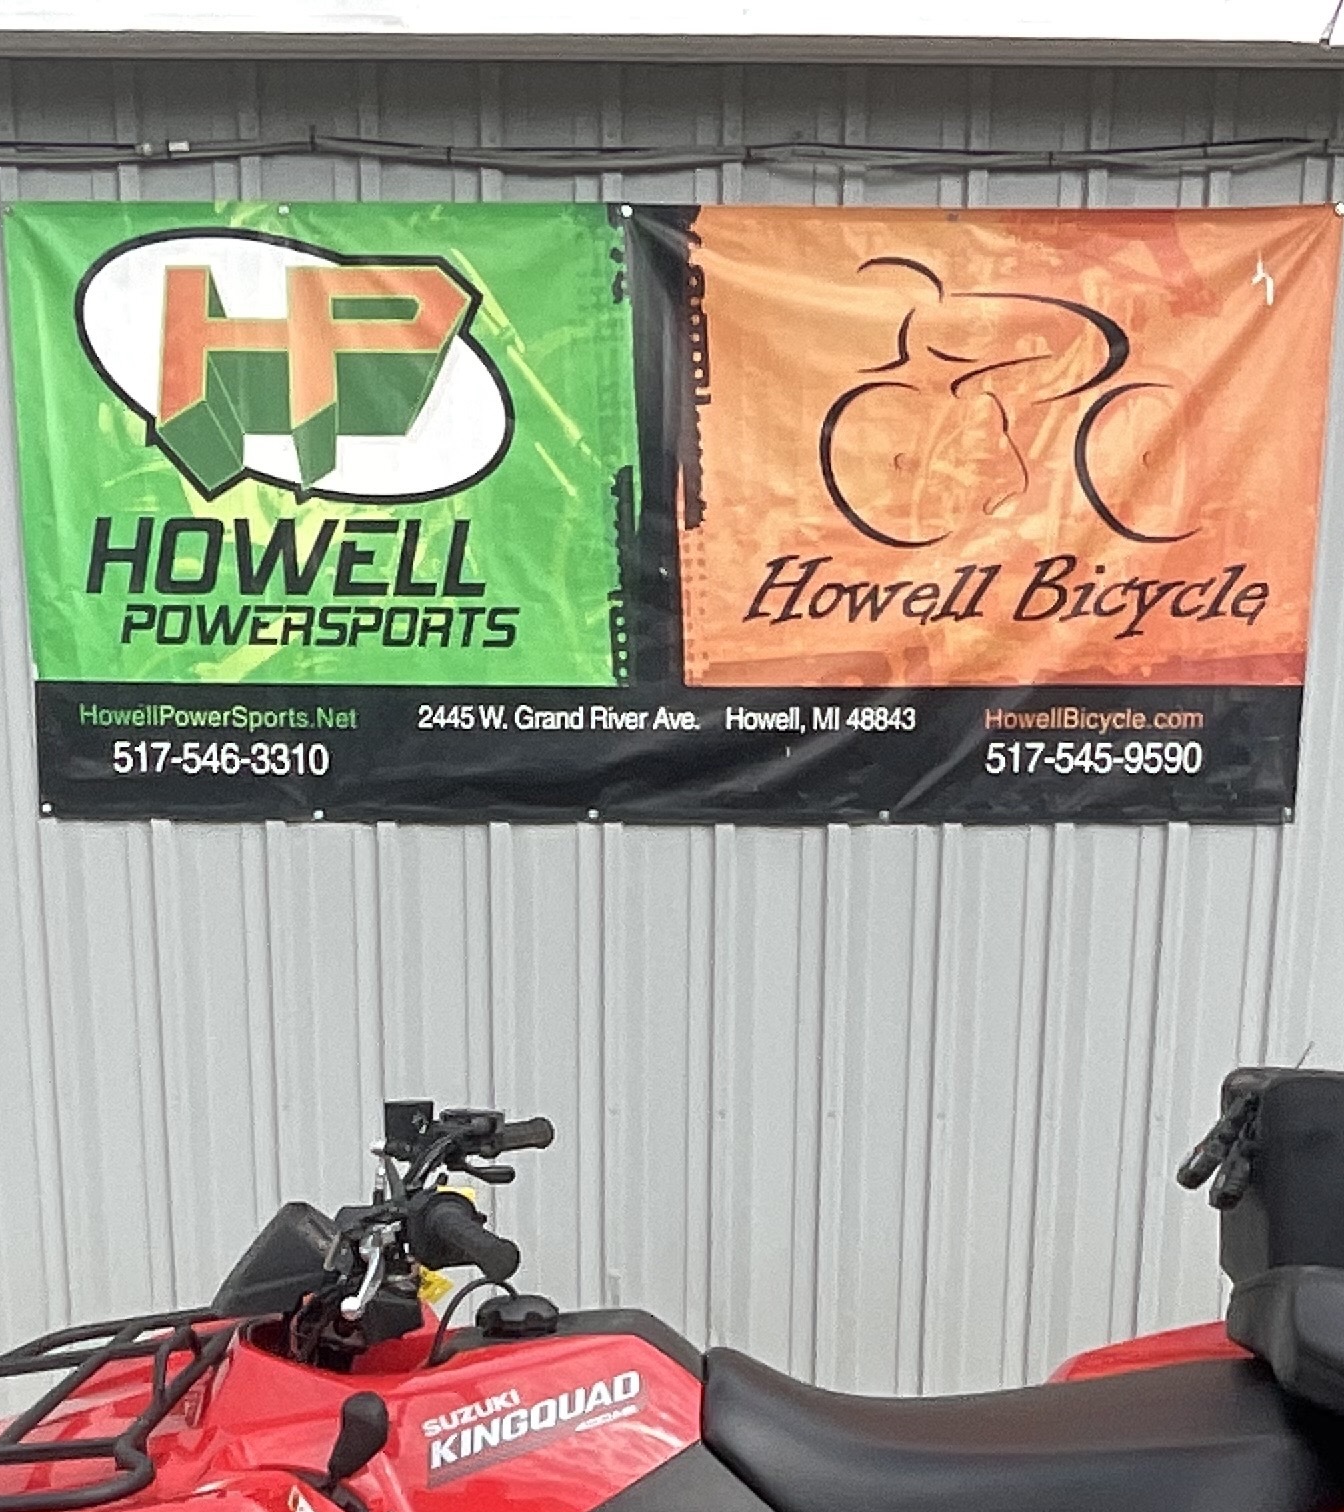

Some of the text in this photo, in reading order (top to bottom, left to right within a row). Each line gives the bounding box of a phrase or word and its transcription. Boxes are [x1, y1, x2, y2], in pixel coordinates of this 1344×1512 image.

[156, 264, 471, 429] HP
[86, 516, 487, 598] HOWELL
[742, 554, 1270, 640] Howell Bicycle
[120, 604, 521, 648] POWERSPORTS
[78, 703, 358, 732] HowellPowerSports.Net
[417, 704, 917, 734] 2445 W. Grand River Ave. Howell, MI 48843
[984, 706, 1204, 735] HowellBicycle.com
[112, 740, 330, 776] 517-546-3310
[985, 741, 1203, 774] 517-545-9590
[421, 1388, 521, 1437] SUZUKI
[430, 1370, 641, 1470] KINGQUAD
